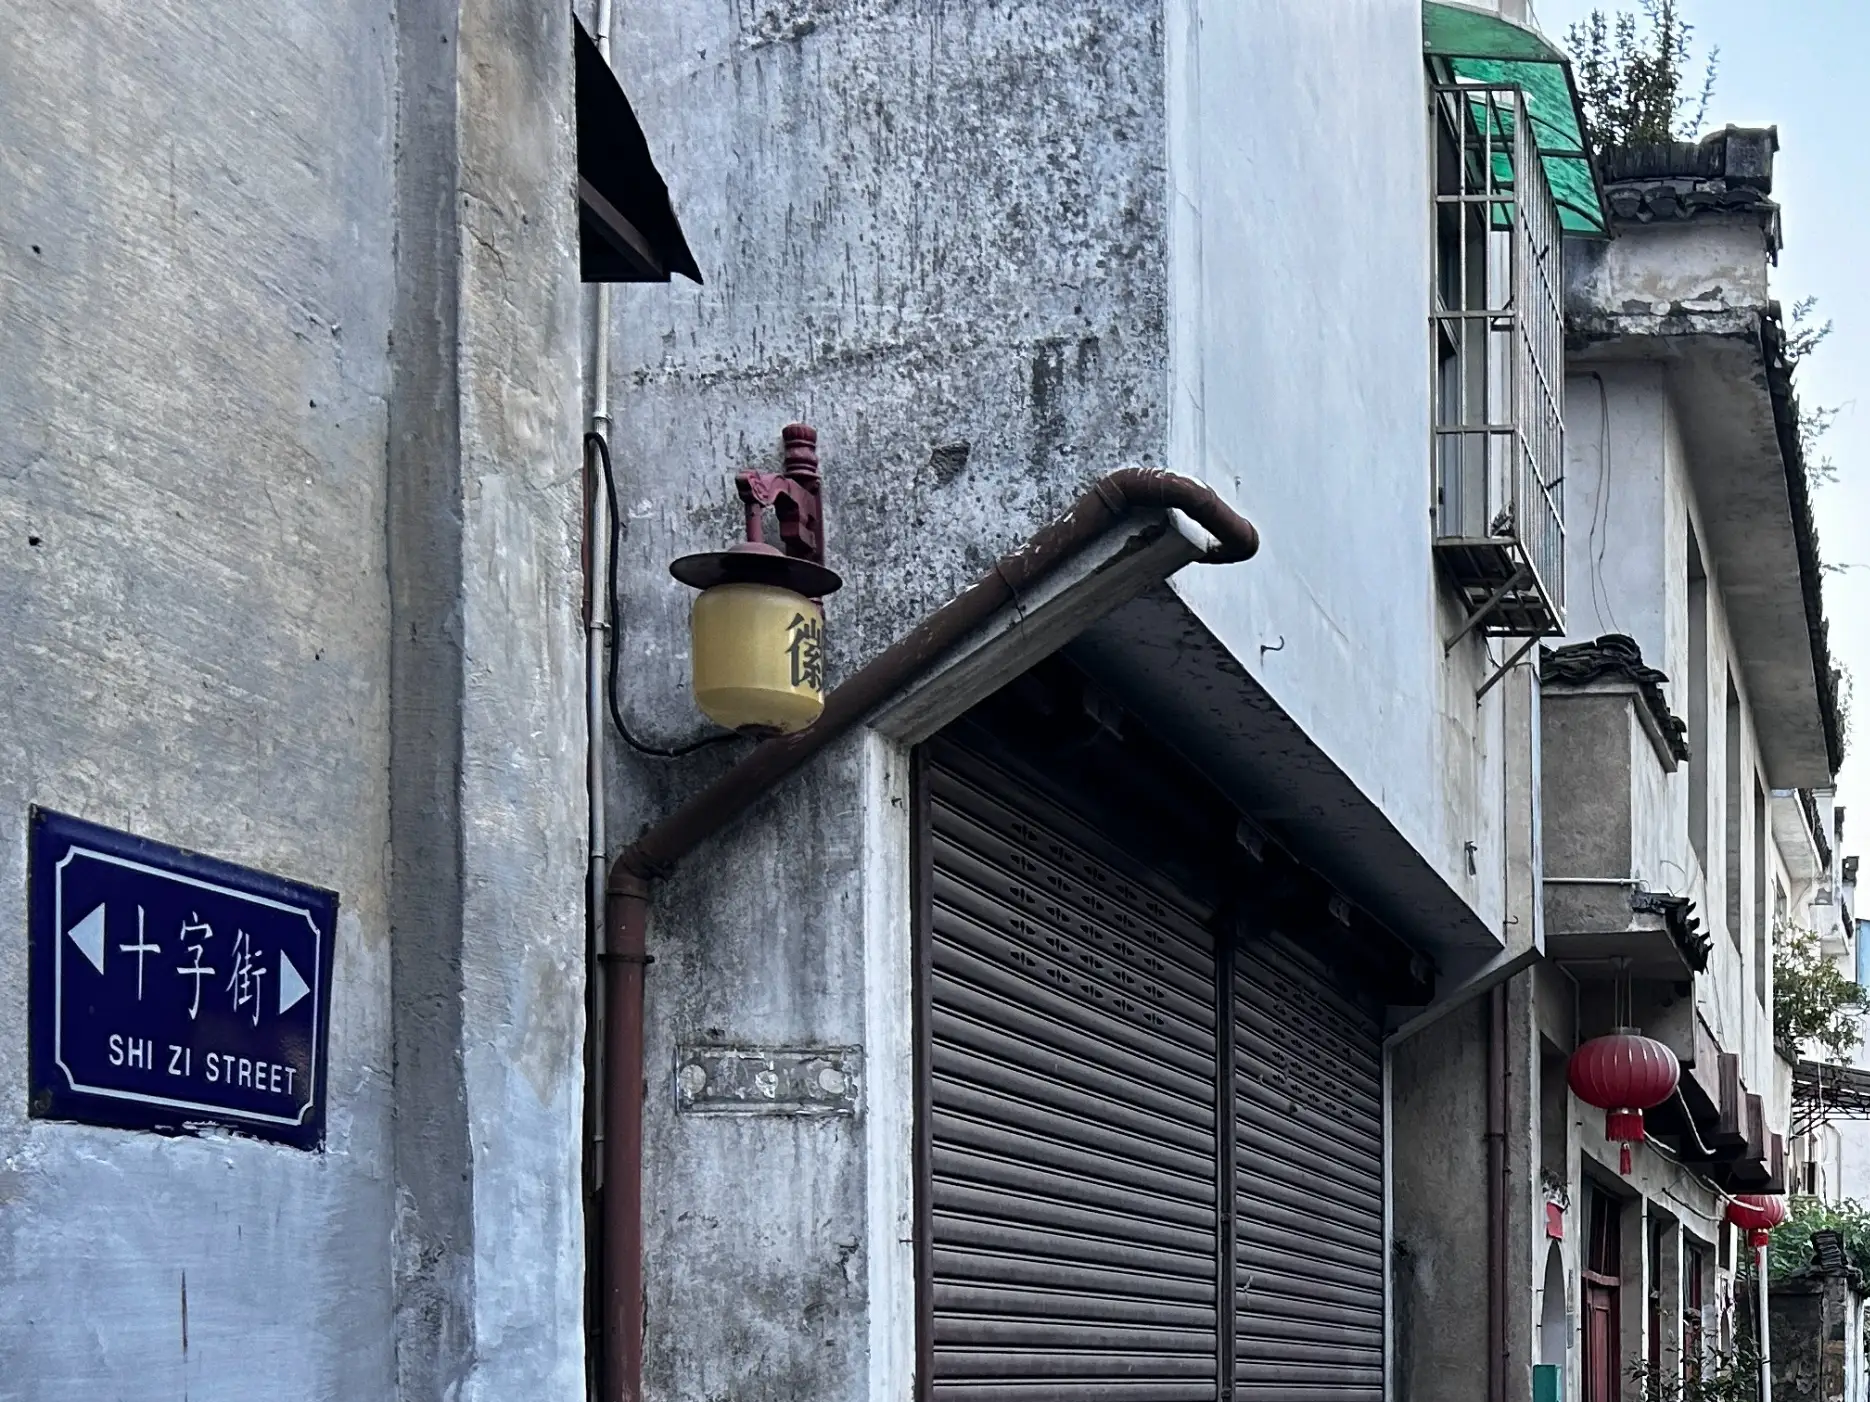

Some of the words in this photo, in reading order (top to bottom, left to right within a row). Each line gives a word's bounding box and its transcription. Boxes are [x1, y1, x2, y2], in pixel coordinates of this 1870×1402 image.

[118, 903, 268, 1027] 十字街
[107, 1033, 154, 1070] SHI
[168, 1044, 191, 1077] ZI
[206, 1051, 298, 1096] STREET
